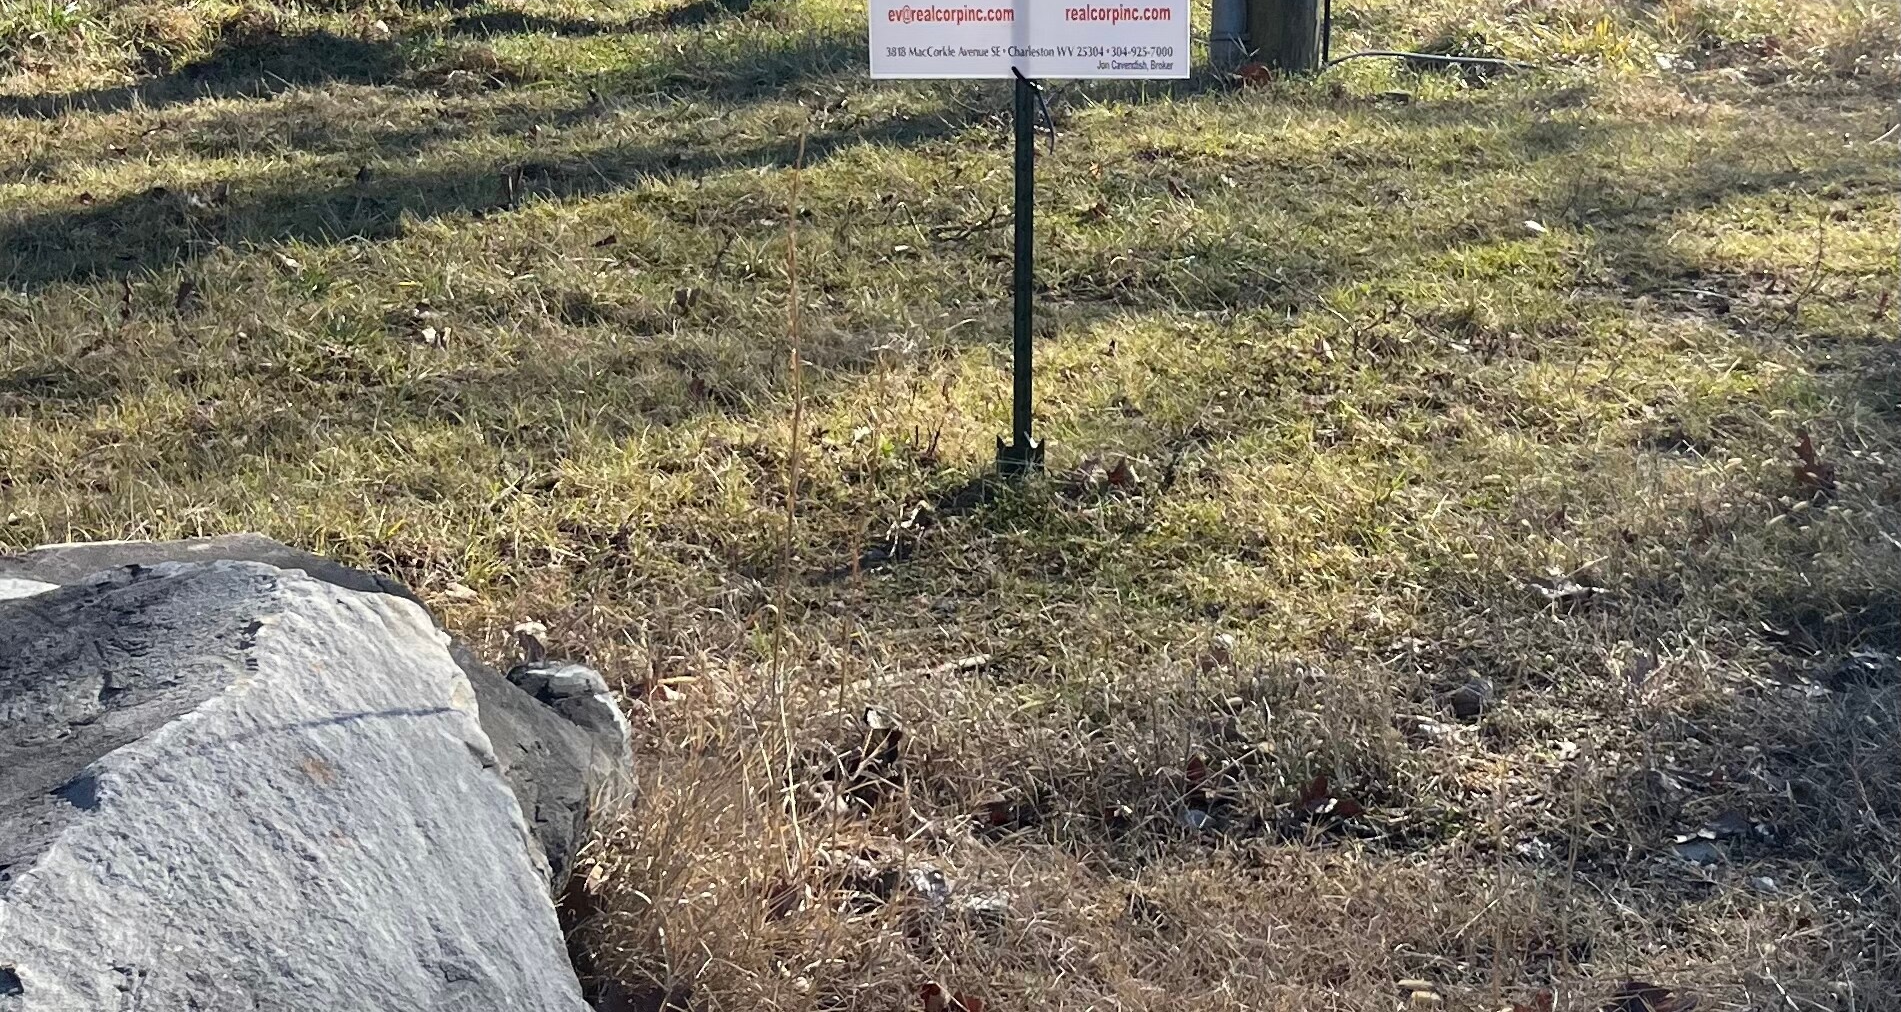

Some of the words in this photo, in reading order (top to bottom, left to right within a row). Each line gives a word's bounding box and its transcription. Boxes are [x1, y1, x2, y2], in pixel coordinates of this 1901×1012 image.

[888, 4, 1015, 25] ev@realcorpinc.com
[1065, 3, 1171, 25] realcorpinc.com
[886, 46, 907, 57] 3818
[909, 45, 955, 57] MacCorkle
[958, 46, 988, 57] Avenue
[991, 46, 1001, 57] SE
[1007, 45, 1055, 57] Charleston
[1056, 45, 1075, 57] WV
[1076, 45, 1104, 57] 25304
[1111, 45, 1174, 57] 304-925-7000
[1096, 60, 1110, 70] Jon
[1111, 59, 1149, 71] Cavendish,
[1150, 59, 1174, 70] Broker
